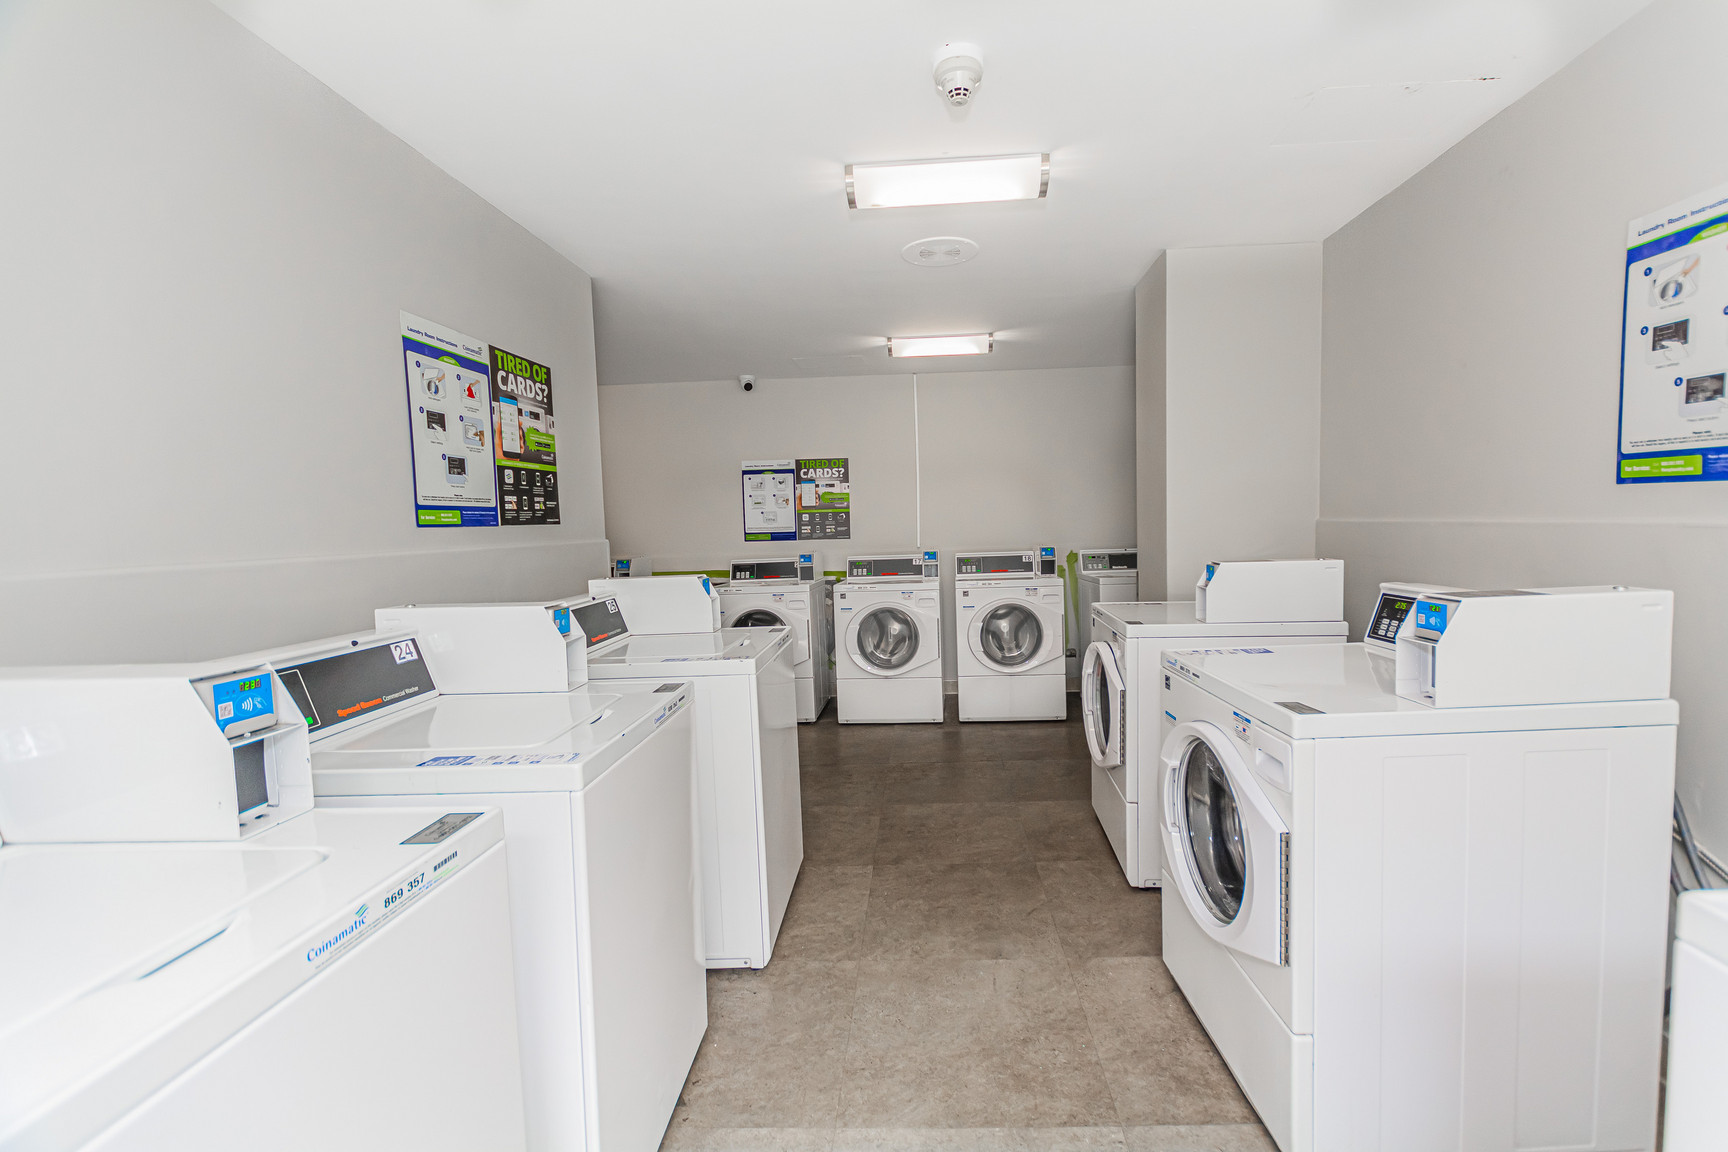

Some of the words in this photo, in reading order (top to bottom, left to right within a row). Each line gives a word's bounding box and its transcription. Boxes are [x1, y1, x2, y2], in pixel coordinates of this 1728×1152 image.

[1638, 223, 1665, 237] Laundry
[1667, 214, 1688, 225] Room
[494, 349, 531, 378] TIRED
[532, 364, 548, 384] OF
[497, 370, 549, 403] CARDS?
[799, 459, 829, 469] TIRED
[830, 459, 845, 468] OF
[800, 468, 845, 478] CARDS?
[394, 642, 414, 661] 24
[382, 690, 406, 702] Commercial
[405, 686, 419, 695] Washer
[384, 888, 404, 909] 869
[407, 872, 425, 892] 357
[306, 915, 367, 962] Coinamatic
